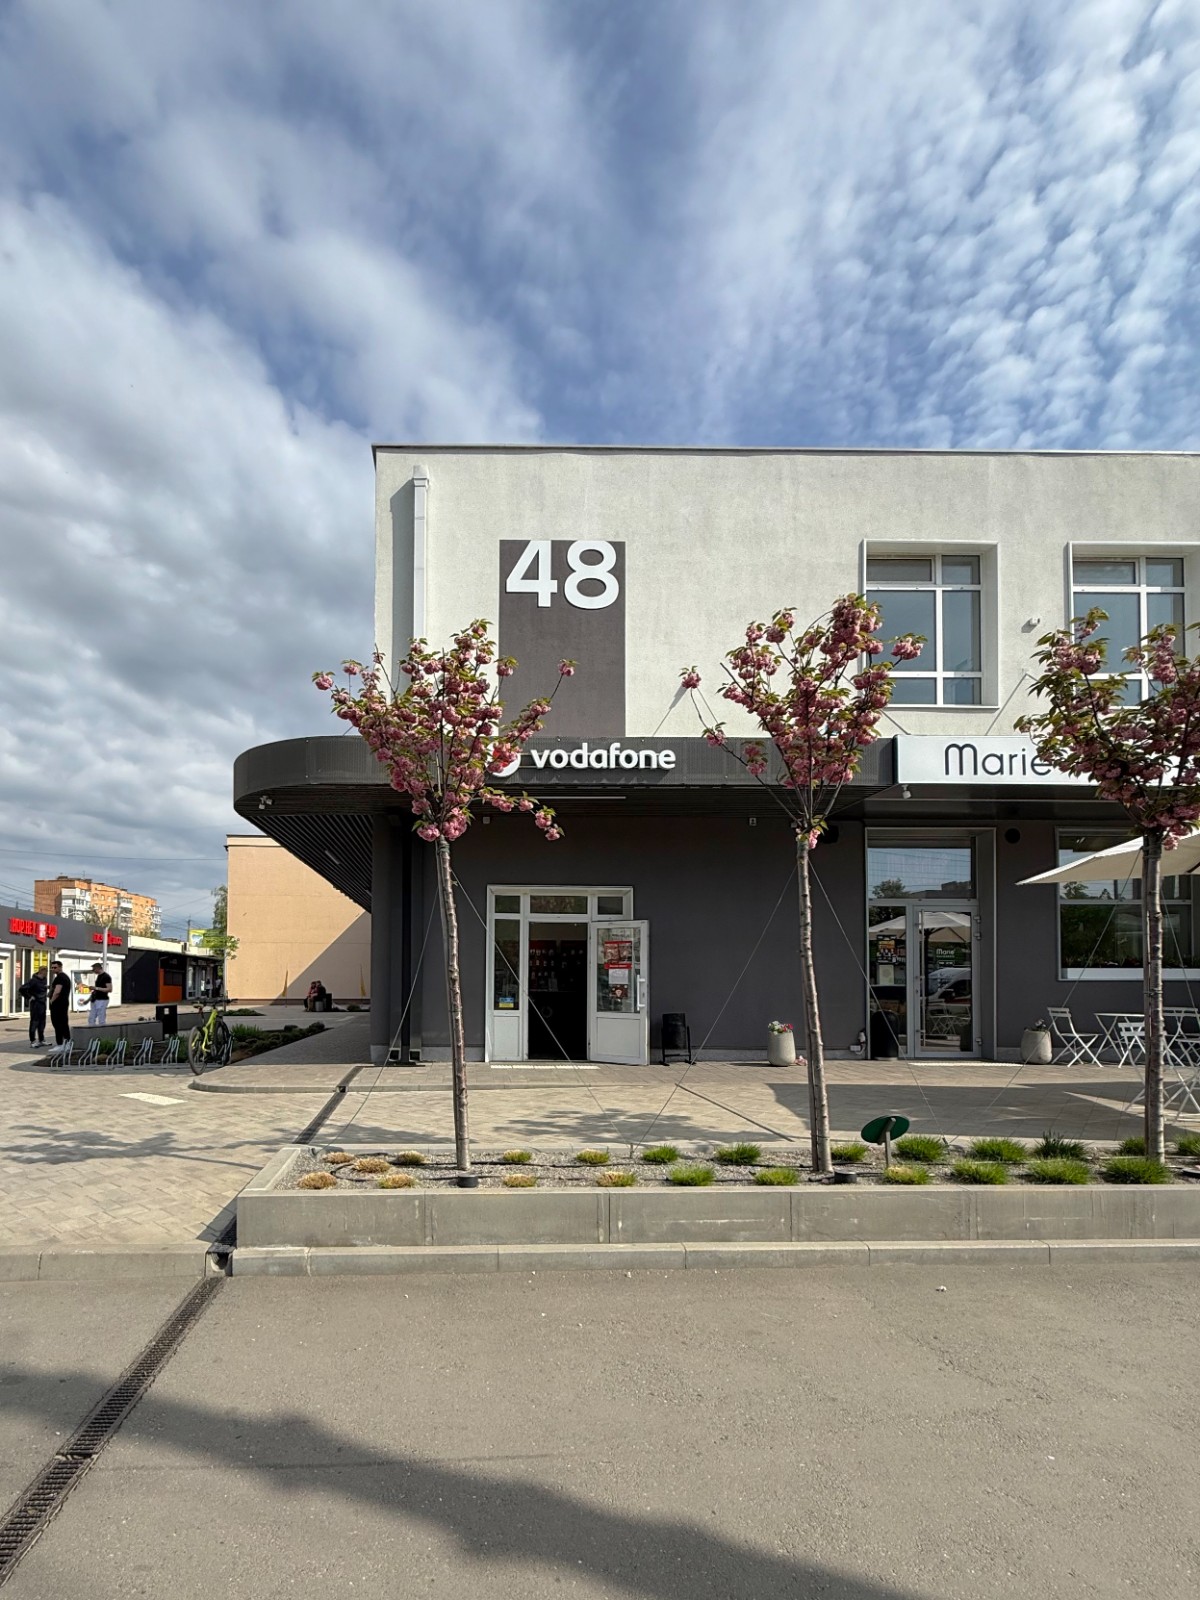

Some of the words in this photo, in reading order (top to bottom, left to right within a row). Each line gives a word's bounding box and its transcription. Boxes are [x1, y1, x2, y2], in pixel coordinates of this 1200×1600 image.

[506, 540, 619, 610] 48
[531, 742, 676, 770] vodafone
[945, 743, 1052, 776] Marie
